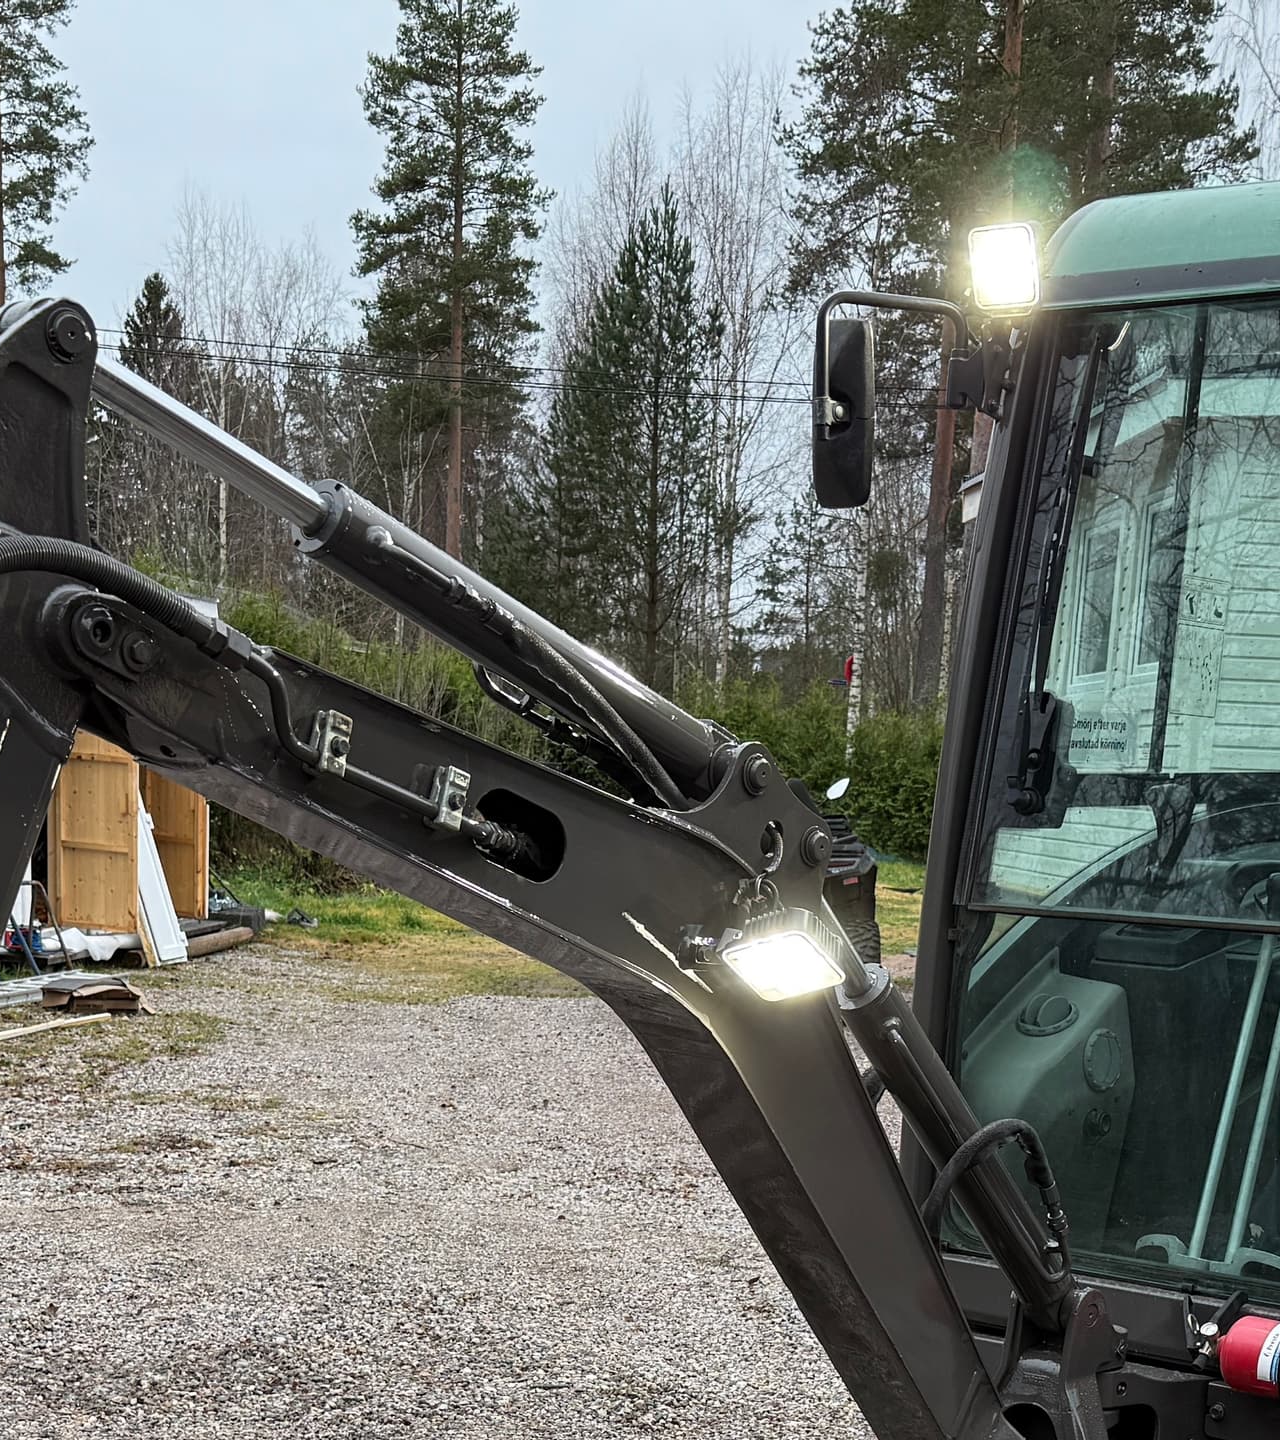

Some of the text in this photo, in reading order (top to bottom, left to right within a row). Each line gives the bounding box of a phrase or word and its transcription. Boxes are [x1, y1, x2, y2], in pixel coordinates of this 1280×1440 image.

[1093, 718, 1110, 731] efter
[1110, 719, 1128, 734] varje
[1071, 737, 1099, 749] avslutad
[1100, 737, 1128, 753] körning!
